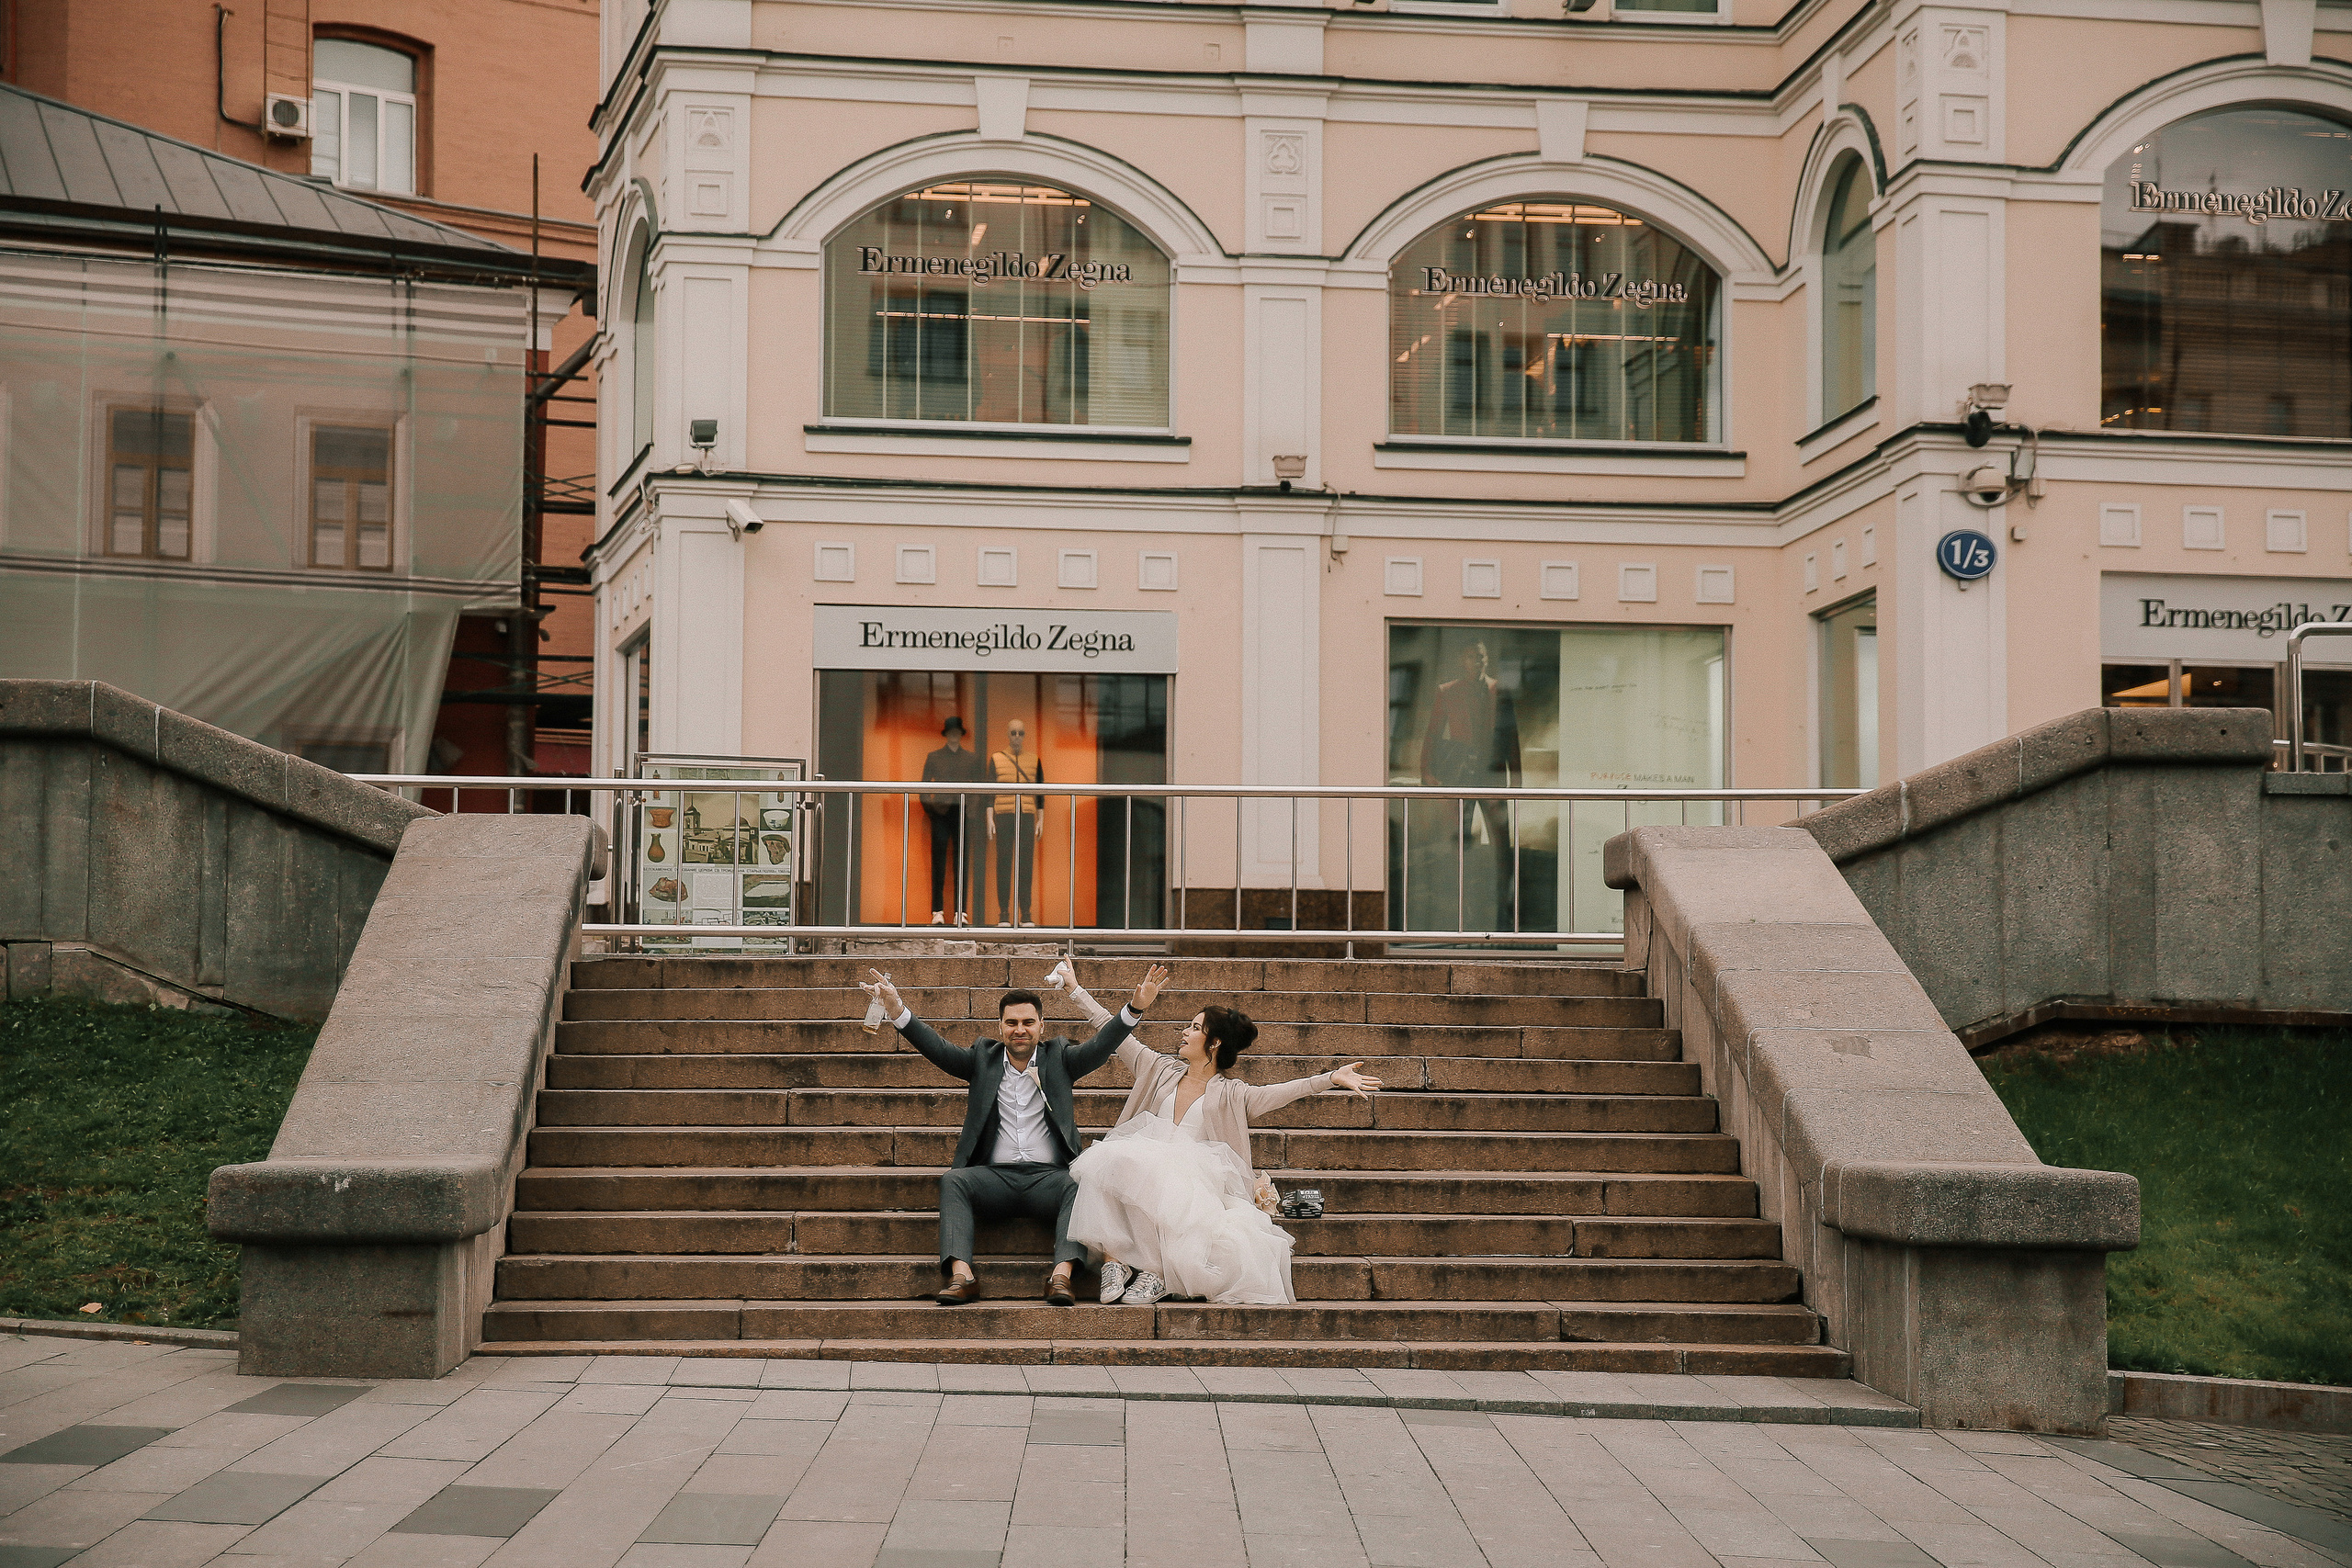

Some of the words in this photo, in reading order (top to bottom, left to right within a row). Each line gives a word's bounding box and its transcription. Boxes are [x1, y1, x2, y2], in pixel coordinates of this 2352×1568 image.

[2129, 180, 2317, 224] Ermenegildo
[856, 245, 1040, 288] Ermenegildo
[1043, 253, 1133, 291] Zegna
[1420, 266, 1596, 304] Ermenegildo
[1600, 272, 1689, 309] Zegna
[1951, 538, 1989, 569] 1/3
[858, 621, 1042, 657] Ermenegildo
[1046, 625, 1136, 659] Zegna
